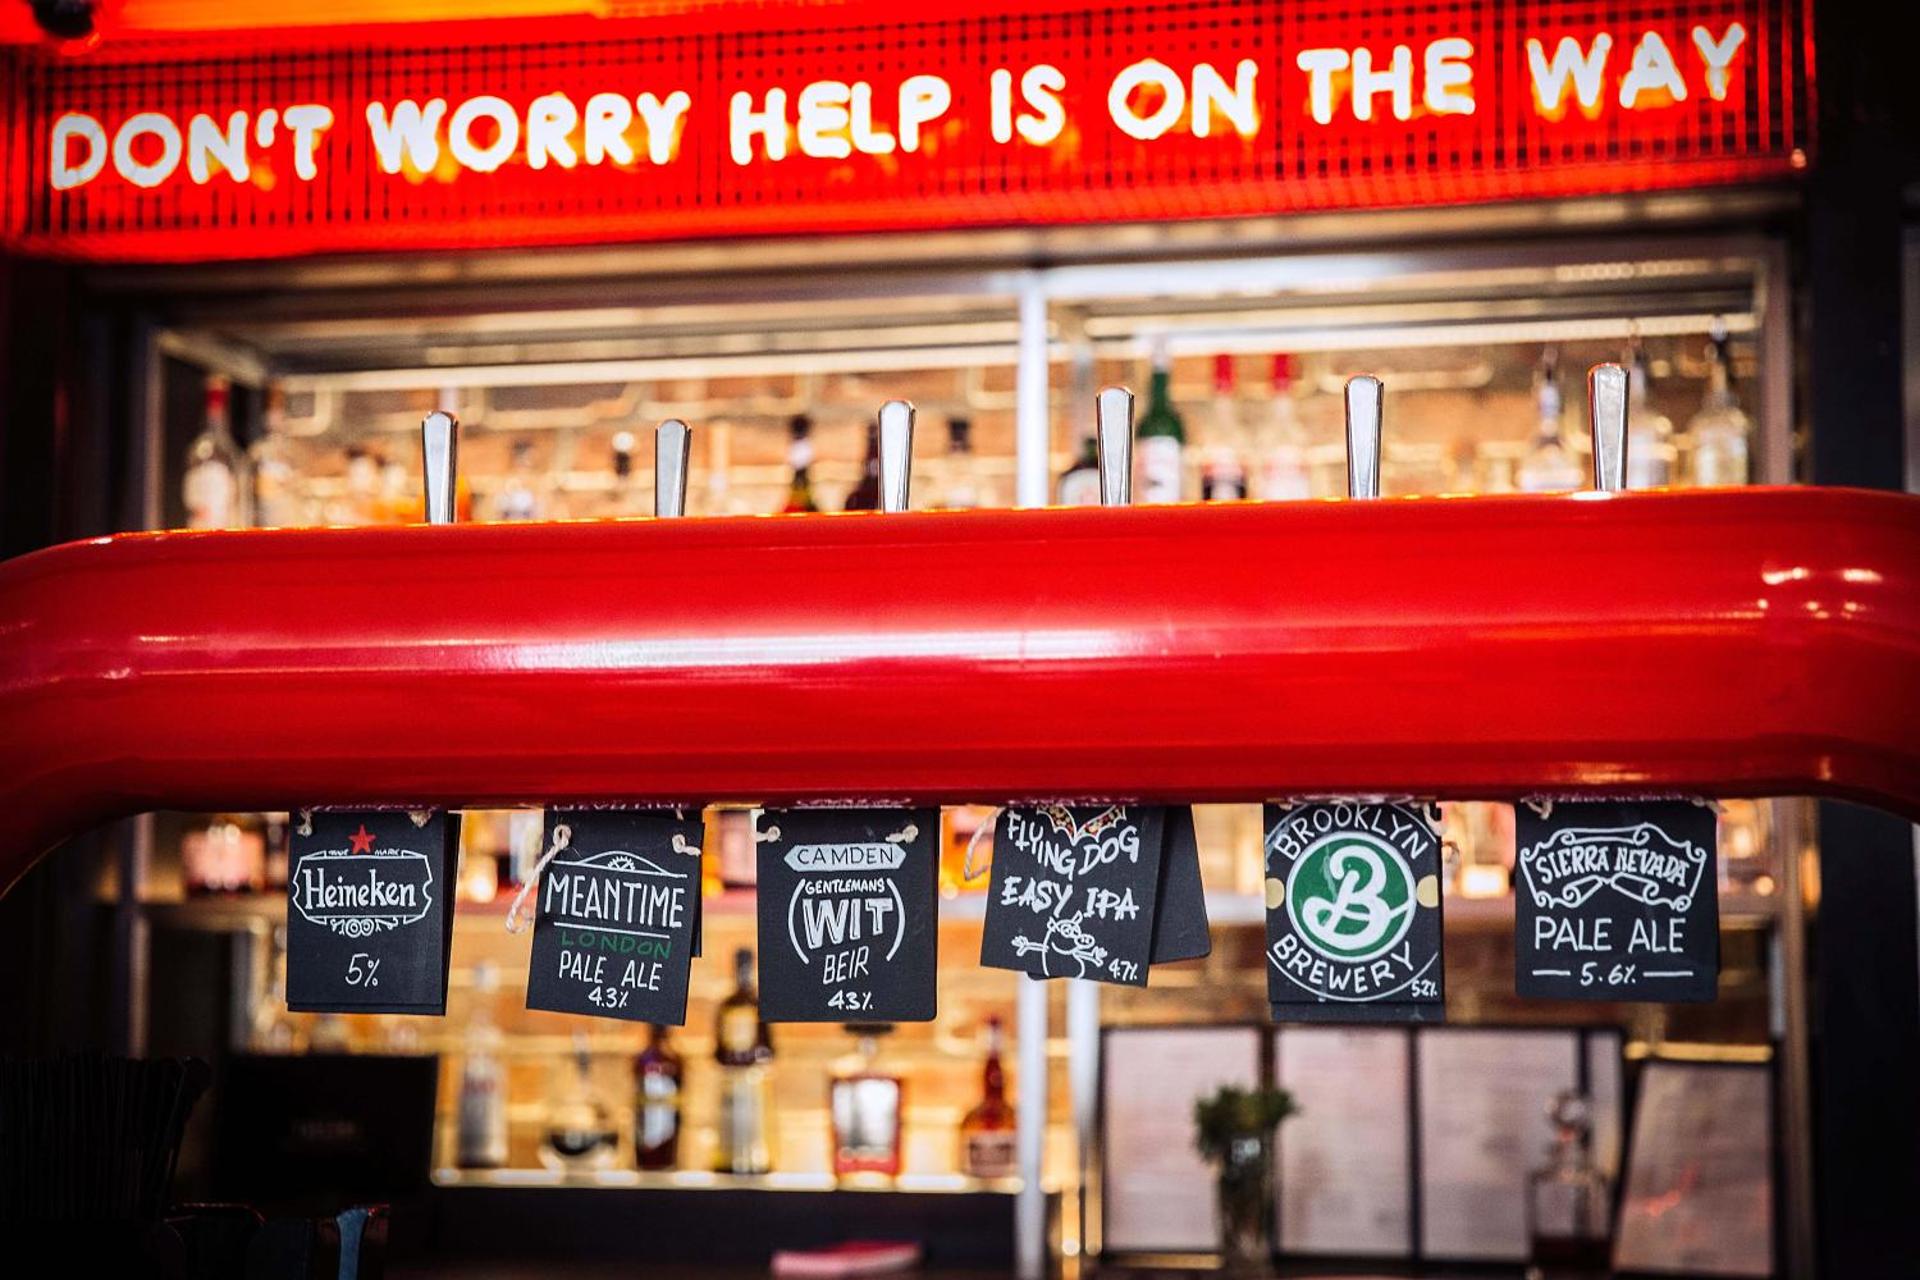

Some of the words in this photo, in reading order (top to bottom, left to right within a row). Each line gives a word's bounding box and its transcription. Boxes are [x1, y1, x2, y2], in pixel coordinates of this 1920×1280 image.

[51, 104, 333, 190] DON'T
[365, 90, 691, 175] WORRY
[729, 74, 952, 166] HELP
[990, 63, 1067, 145] IS
[1106, 58, 1259, 140] ON
[1296, 37, 1477, 126] THE
[1526, 22, 1746, 111] WAY
[1007, 810, 1076, 881] FLYING
[1078, 825, 1140, 875] DOG
[1274, 804, 1428, 861] BROOKLYN
[796, 846, 894, 866] CAMDEN
[1535, 845, 1610, 885] SIERRA
[1613, 846, 1690, 888] NEVADA
[302, 867, 417, 910] Heineken
[544, 872, 686, 928] MEANTIME
[804, 877, 886, 895] GENTLEMANS
[999, 875, 1074, 919] EASY
[1082, 887, 1140, 921] IPA
[802, 897, 893, 950] WIT
[1534, 915, 1613, 952] PALE
[1627, 917, 1687, 954] ALE
[560, 930, 673, 960] LONDON
[822, 945, 870, 985] BEIR
[1273, 932, 1414, 994] BREWERY
[345, 952, 380, 988] 5%
[558, 950, 608, 984] PALE
[620, 959, 663, 991] ALE
[1579, 961, 1637, 987] 5.6%
[587, 985, 629, 1009] 4.3%
[827, 989, 874, 1011] 4.3%
